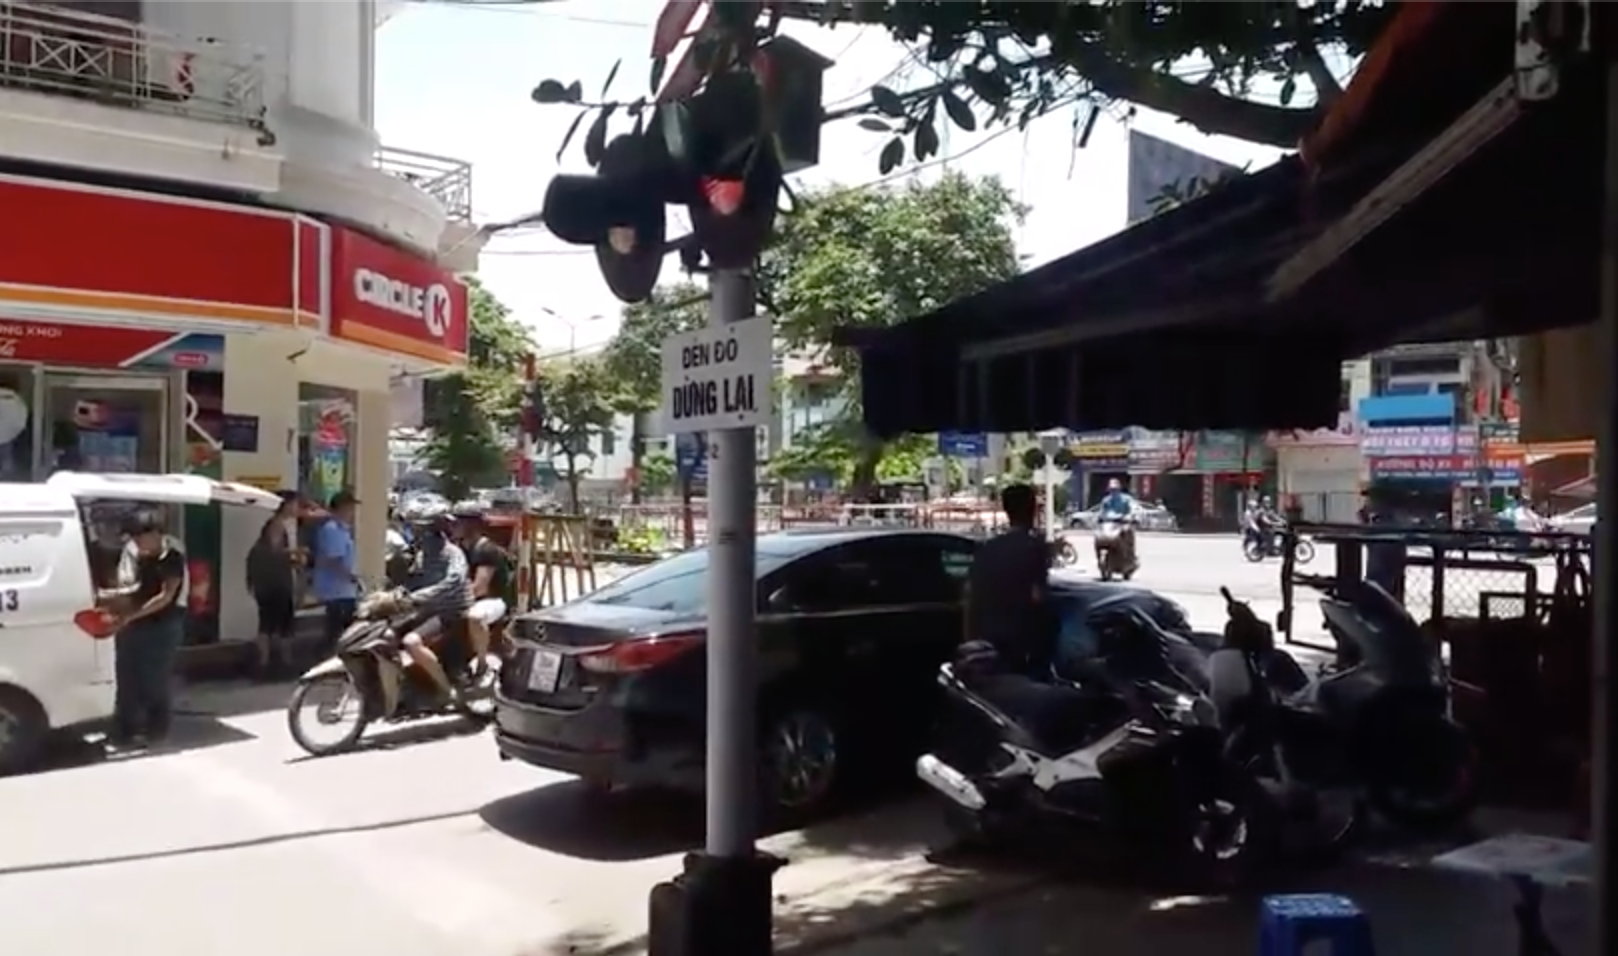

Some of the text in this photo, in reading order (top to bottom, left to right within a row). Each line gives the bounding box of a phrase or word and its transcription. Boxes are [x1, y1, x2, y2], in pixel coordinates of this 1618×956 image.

[354, 267, 424, 319] CIRCLE
[682, 326, 739, 369] ĐÈN ĐỎ
[672, 375, 718, 420] DỪNG
